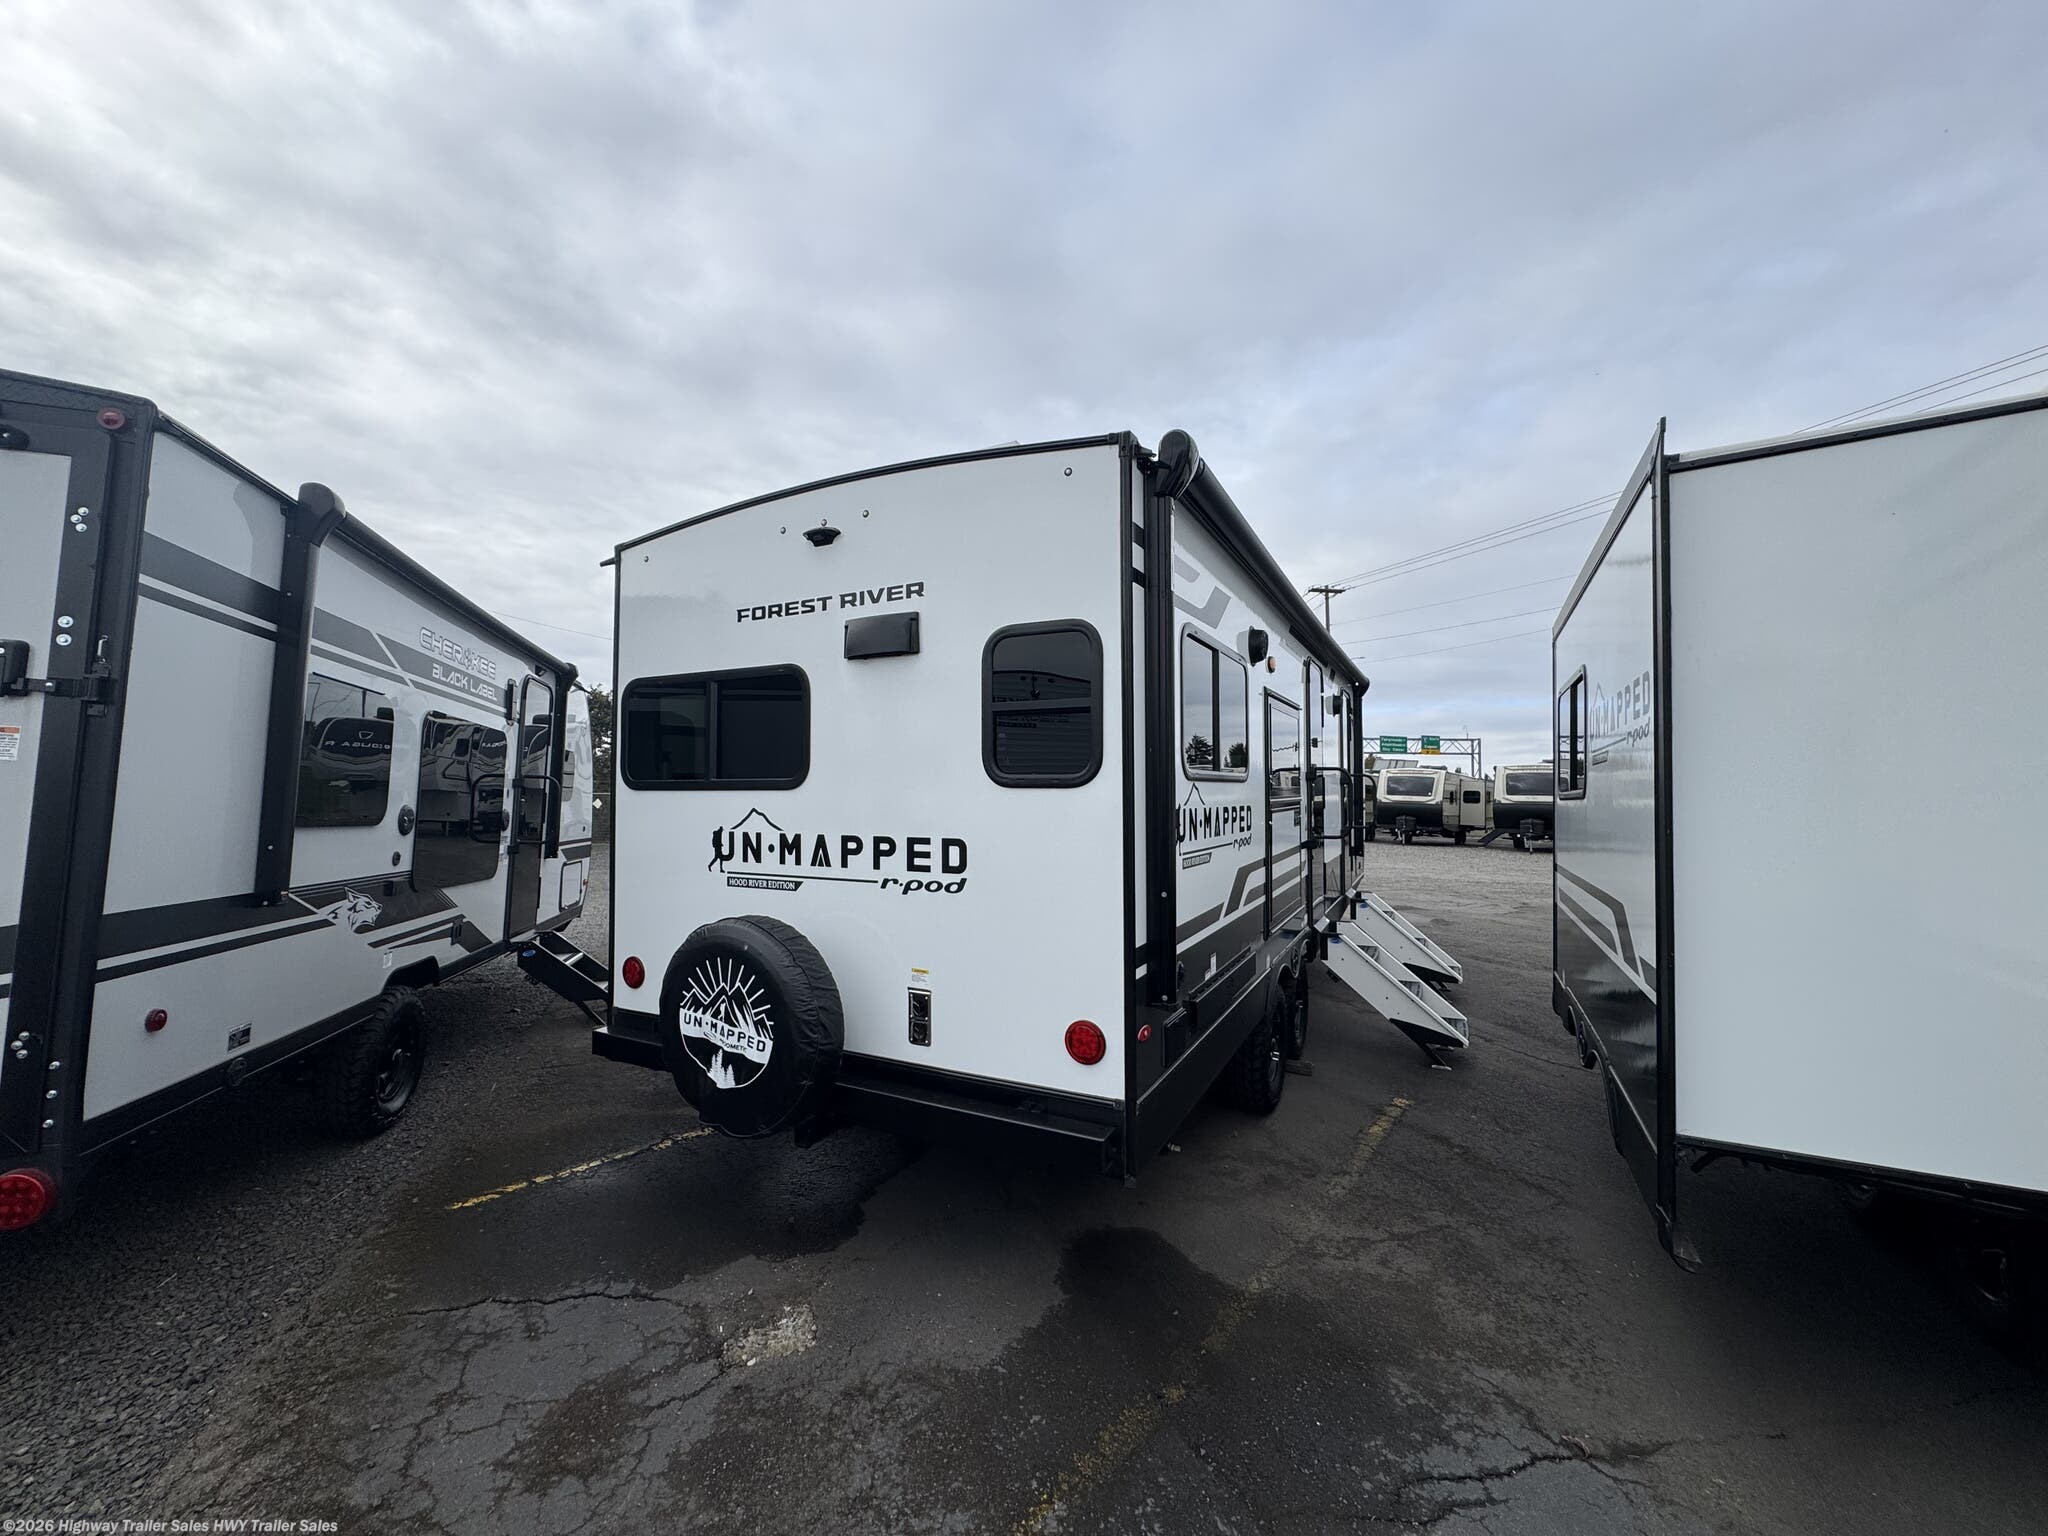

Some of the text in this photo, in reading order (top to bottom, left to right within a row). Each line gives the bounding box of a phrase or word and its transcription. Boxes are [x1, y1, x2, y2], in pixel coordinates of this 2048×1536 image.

[737, 581, 925, 622] FOREST RIVER
[432, 662, 498, 702] BLACK LABEL
[728, 877, 796, 891] HOOD RIVER EDITION
